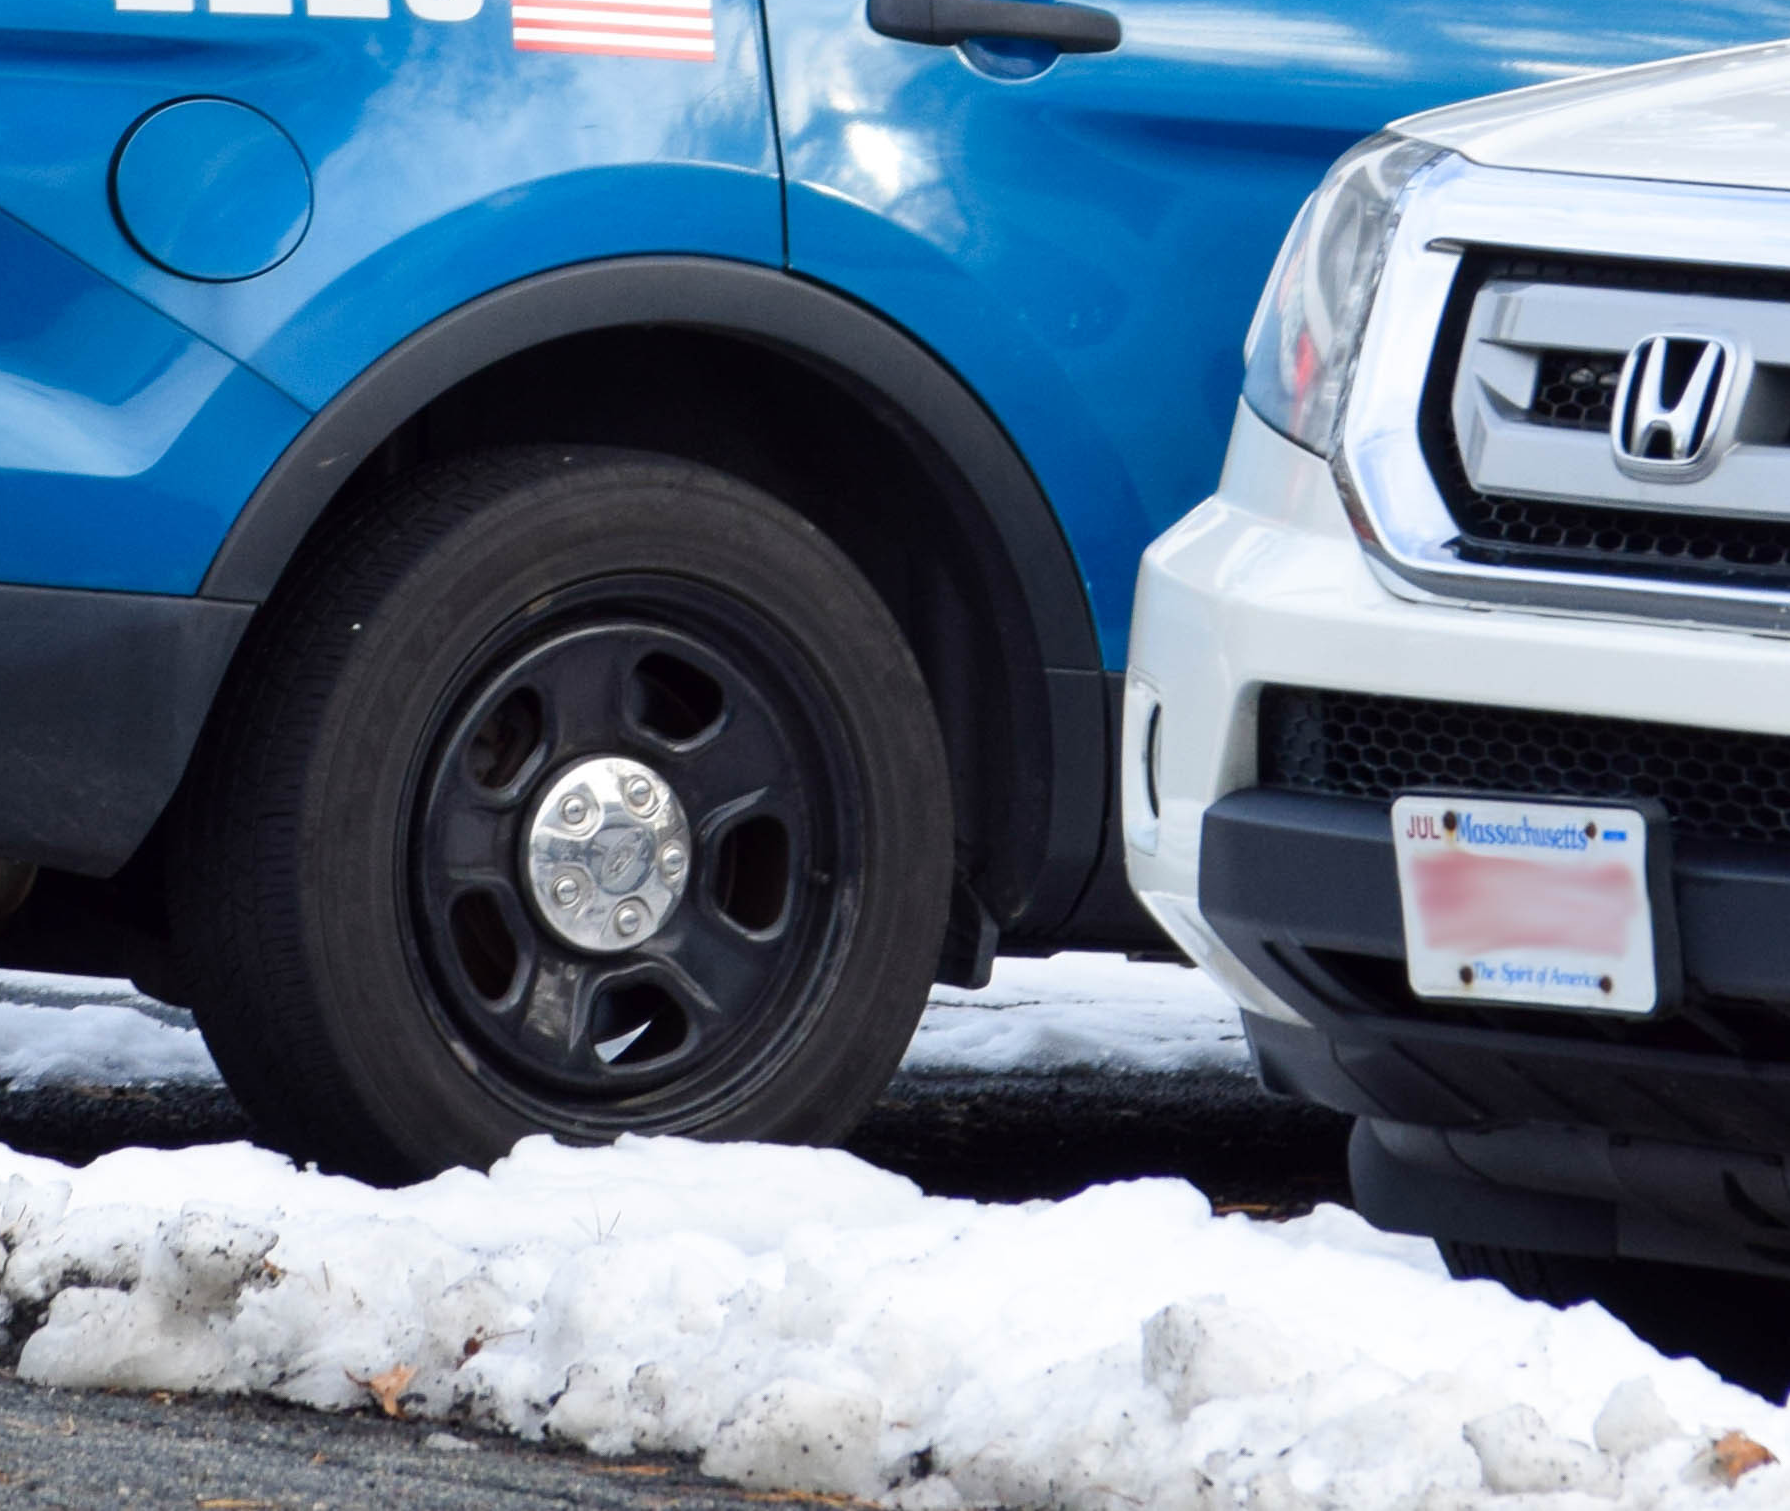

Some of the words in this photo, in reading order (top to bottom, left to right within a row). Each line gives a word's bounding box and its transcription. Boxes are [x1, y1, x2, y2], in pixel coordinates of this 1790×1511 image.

[1406, 815, 1441, 840] JUL
[1456, 812, 1588, 851] Massachusetts
[1473, 961, 1495, 980] The
[1502, 962, 1533, 985] Spirit
[1536, 967, 1547, 987] of
